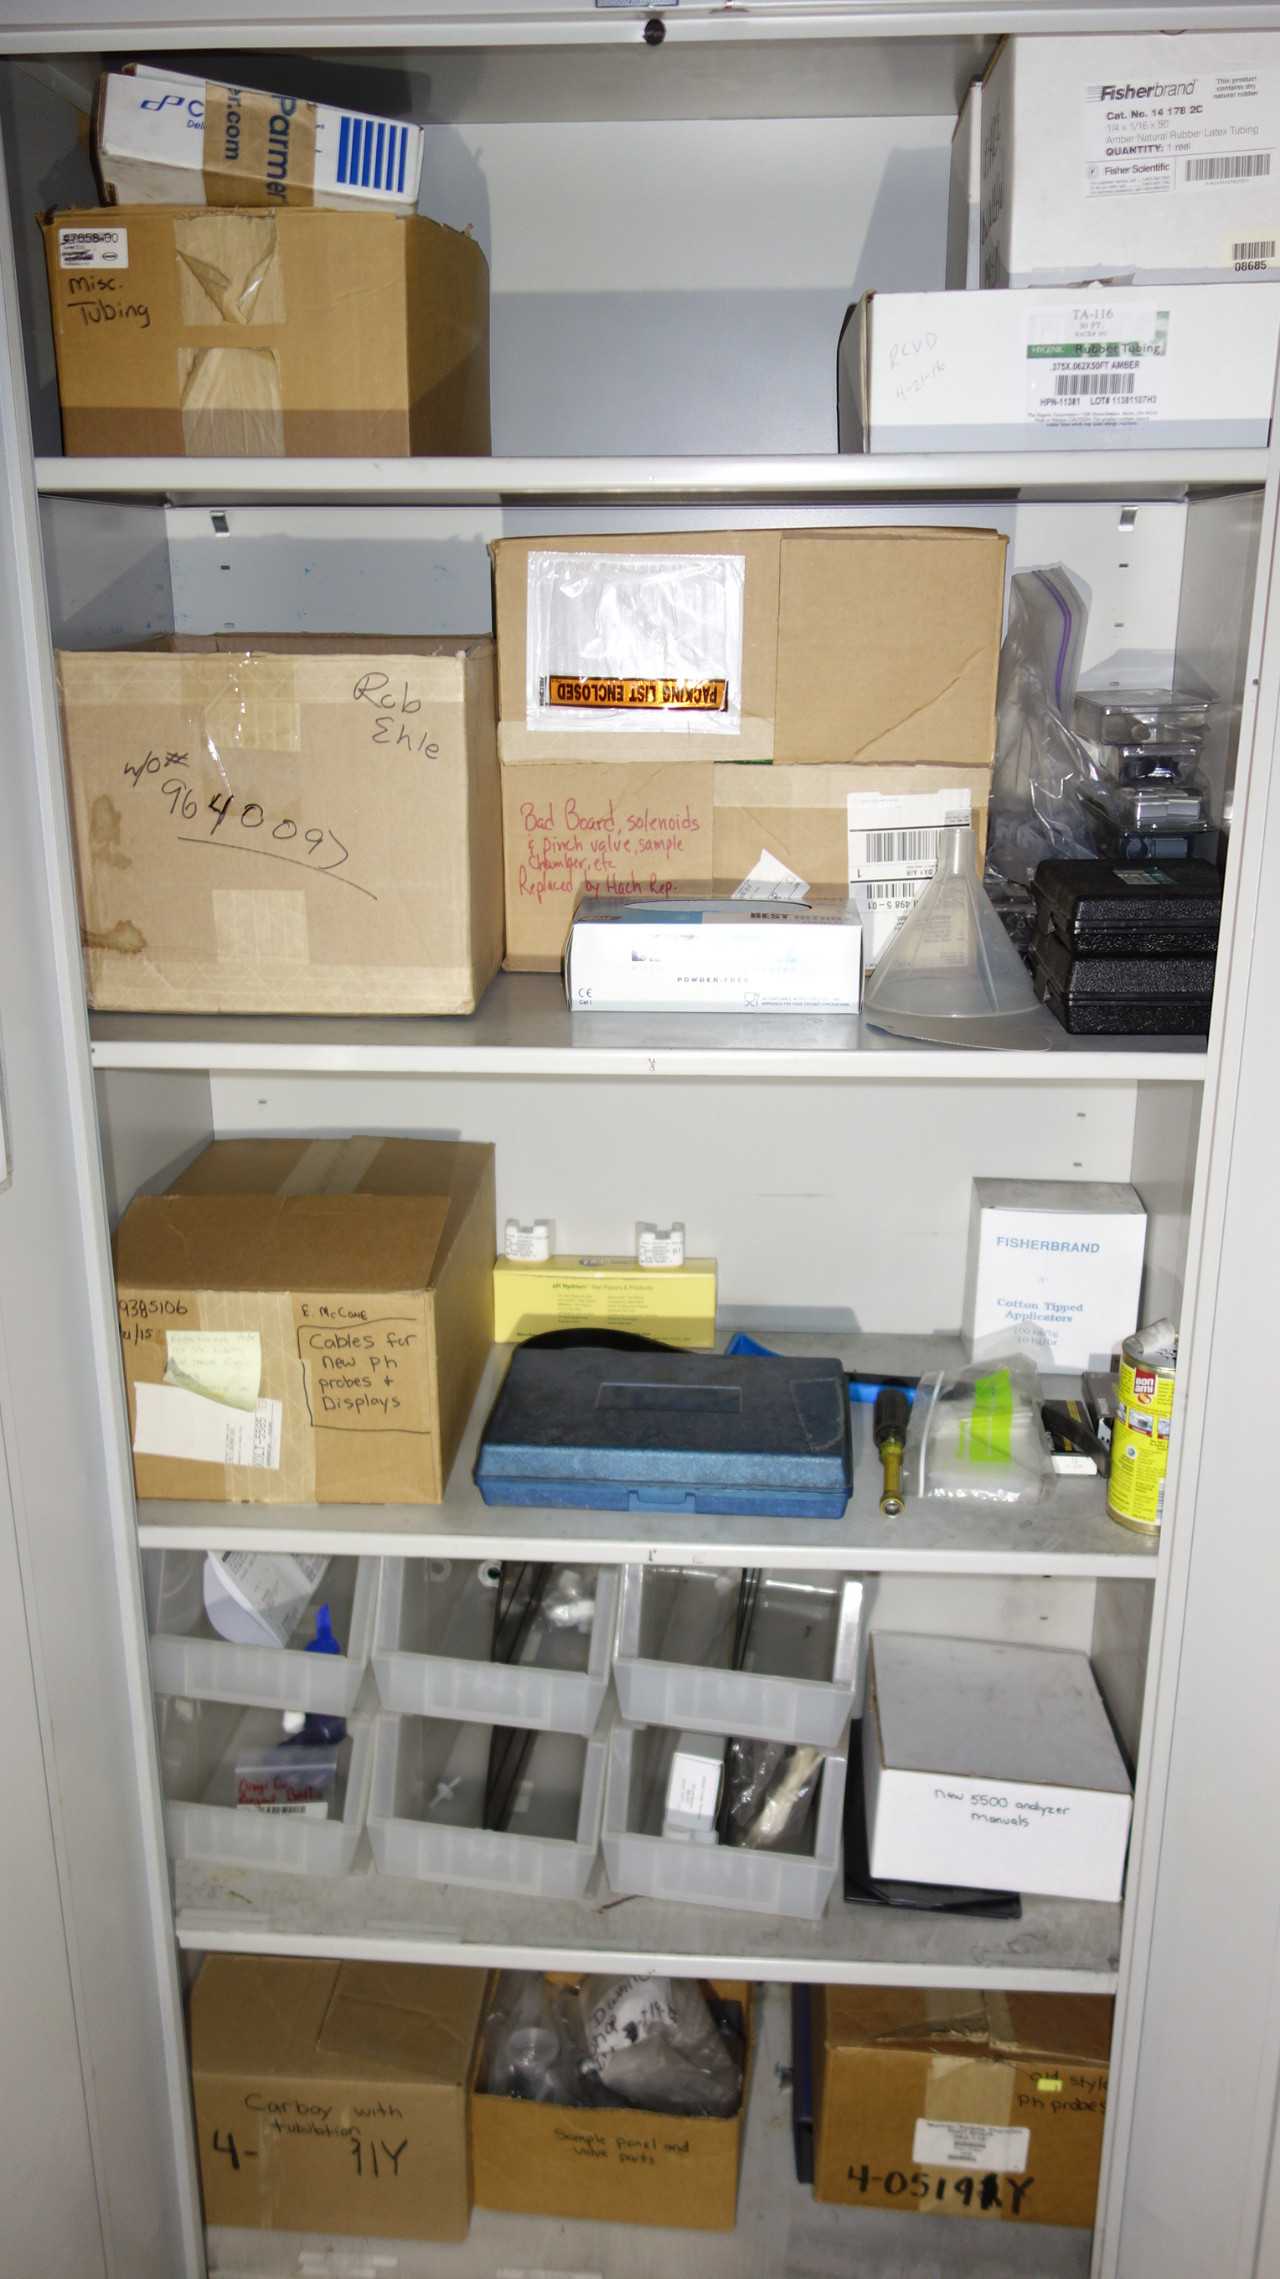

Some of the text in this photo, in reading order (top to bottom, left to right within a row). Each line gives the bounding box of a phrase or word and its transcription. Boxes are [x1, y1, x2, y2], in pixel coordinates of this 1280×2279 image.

[1100, 81, 1196, 101] Fisherbrand
[1106, 111, 1127, 120] Cat.
[1131, 110, 1148, 119] No.
[1105, 134, 1134, 144] Amber
[1137, 132, 1167, 143] Natural
[1170, 129, 1200, 139] Rubber
[1231, 126, 1259, 136] Tubing
[265, 95, 296, 204] Parmer
[1106, 144, 1164, 156] QUANTITY:
[1105, 162, 1170, 176] Fisher Scientific
[1234, 260, 1268, 272] 08685
[67, 299, 151, 328] Tubing
[1072, 308, 1114, 320] TA-116
[1075, 344, 1119, 354] Rubber
[1121, 343, 1161, 355] Tubing
[1111, 360, 1140, 369] AMBER
[557, 683, 624, 702] ENCLOSED
[629, 685, 656, 703] LIST
[663, 685, 718, 704] PACKING
[520, 802, 555, 831] Bad
[627, 804, 700, 831] solenoids
[585, 870, 600, 896] by
[996, 1236, 1100, 1253] FISHERBRAND
[997, 1299, 1083, 1312] Cotton Tipped
[1006, 1310, 1072, 1322] Applicators
[309, 1332, 417, 1349] Cables for
[318, 1376, 372, 1394] probes
[322, 1393, 400, 1415] Displays
[970, 1794, 1008, 1808] 5500
[1015, 1801, 1070, 1816] analyzer
[971, 1812, 1030, 1827] manuals
[353, 2102, 403, 2119] with
